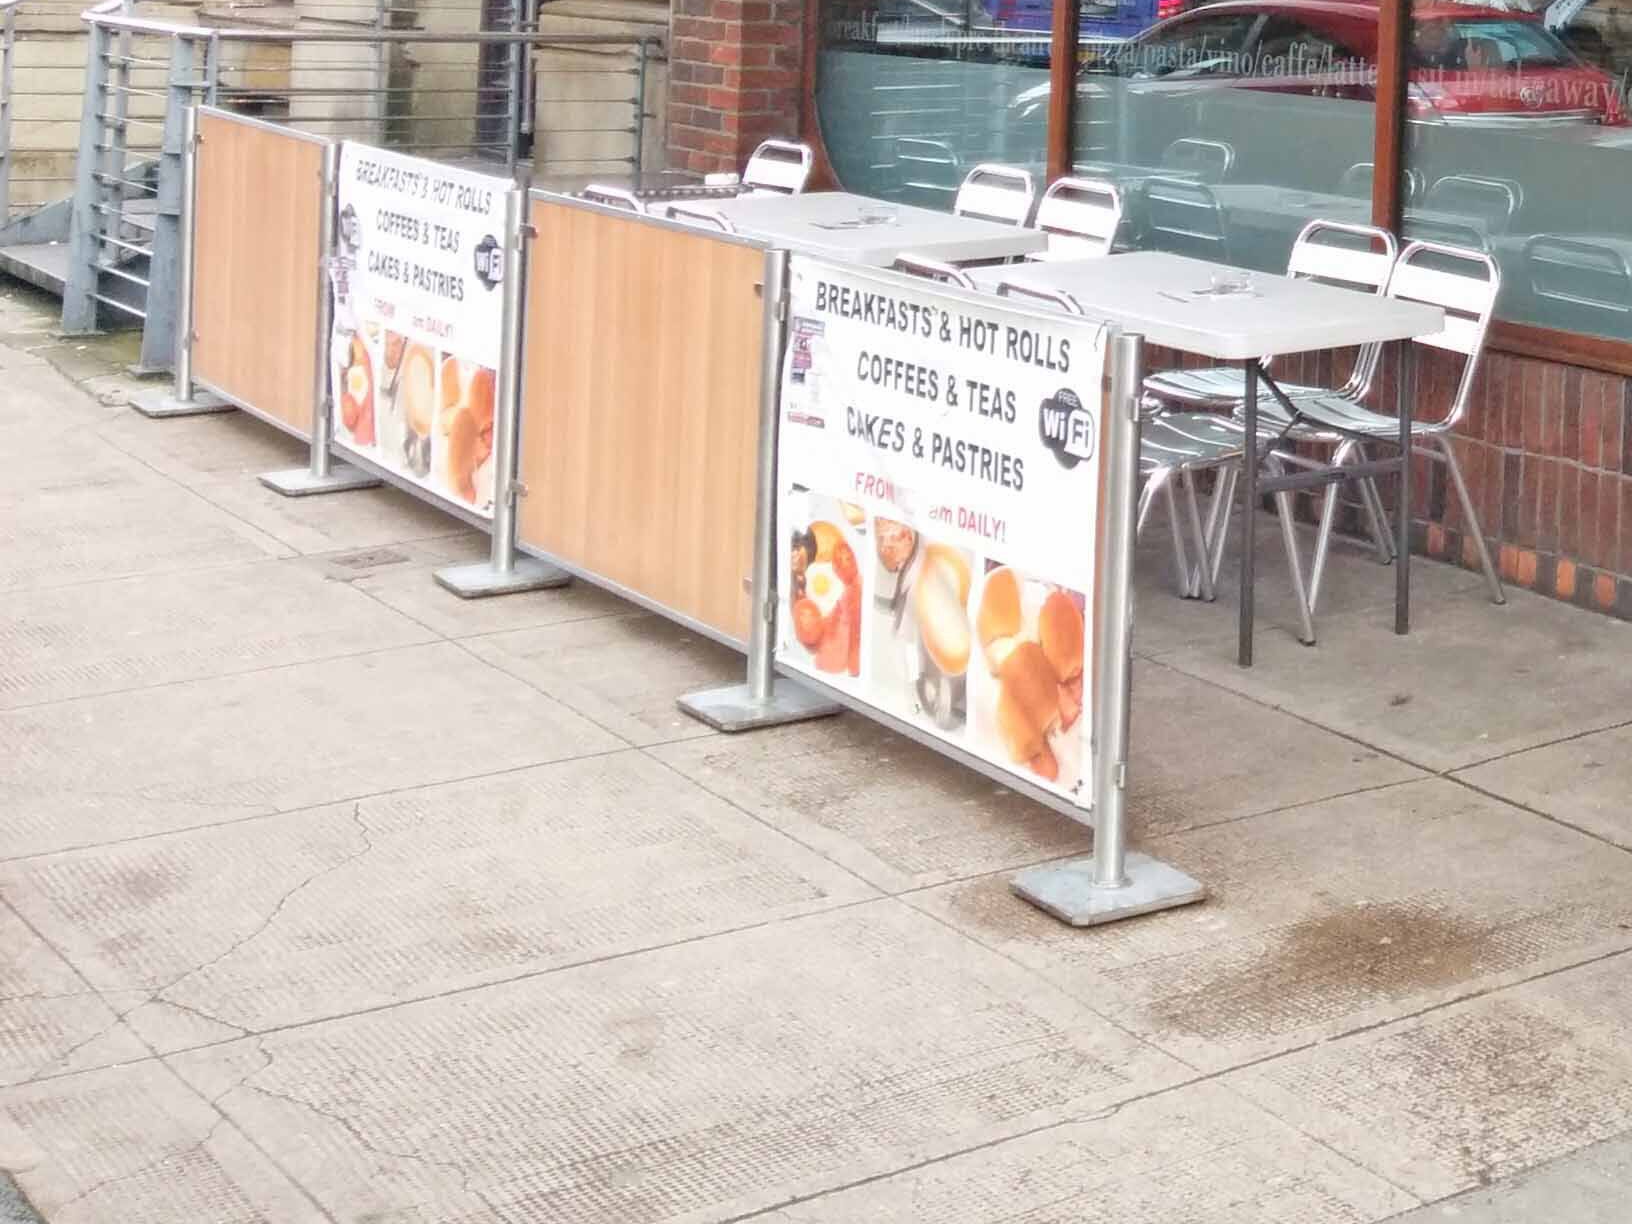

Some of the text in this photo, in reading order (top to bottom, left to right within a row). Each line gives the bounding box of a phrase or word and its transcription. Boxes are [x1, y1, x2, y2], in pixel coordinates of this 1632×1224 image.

[456, 185, 492, 215] ROLLS
[433, 224, 460, 253] TEAS
[412, 264, 465, 301] PASTRIES
[815, 281, 1071, 373] BREAKFASTS & HOT ROLLS
[856, 351, 1016, 424] COFFEES & TEAS
[847, 406, 1024, 492] CAKES & PASTRIES
[957, 506, 1007, 543] DAILY!
